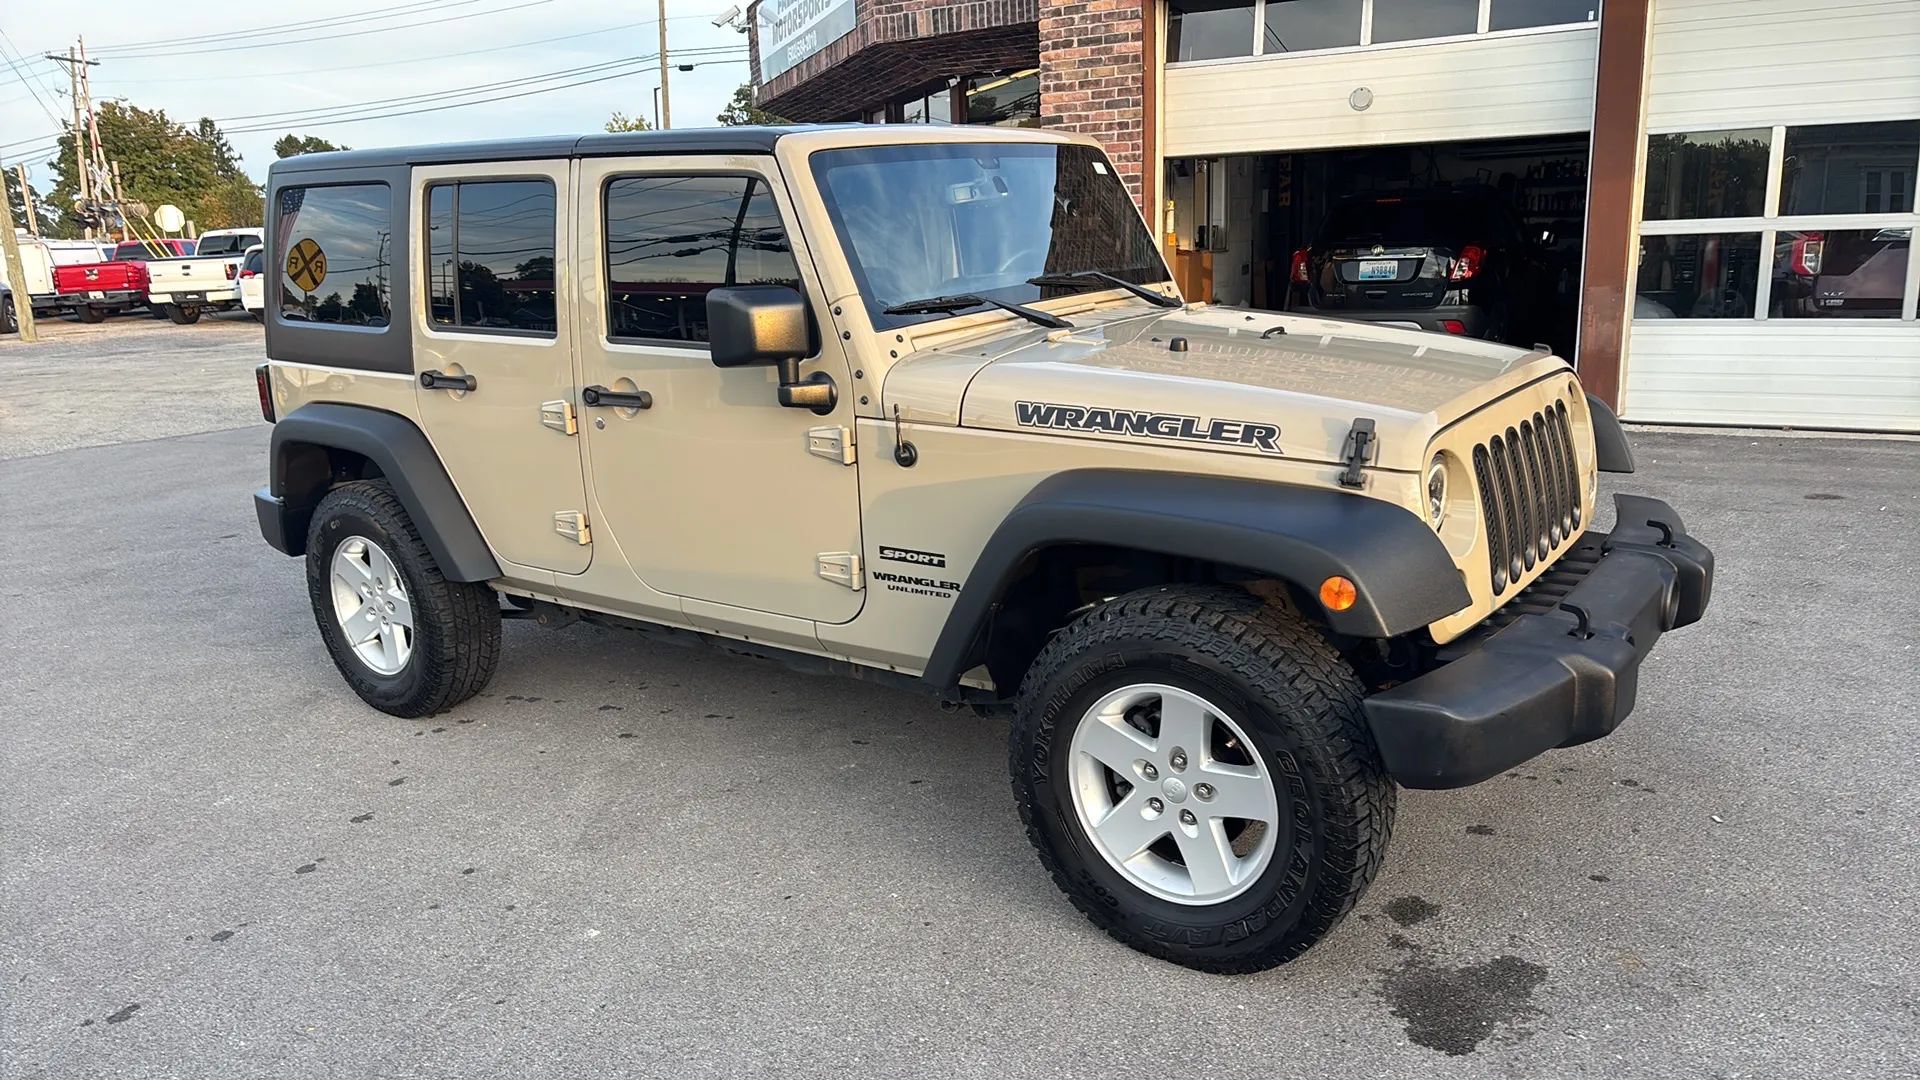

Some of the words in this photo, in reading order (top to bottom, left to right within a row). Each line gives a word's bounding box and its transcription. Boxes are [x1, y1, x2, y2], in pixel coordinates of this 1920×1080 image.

[1015, 400, 1283, 454] WRANGLER
[880, 547, 945, 566] SPORT
[872, 571, 961, 592] WRANGLER
[887, 584, 952, 599] UNLIMITED
[1032, 652, 1127, 785] YOKOHAMA
